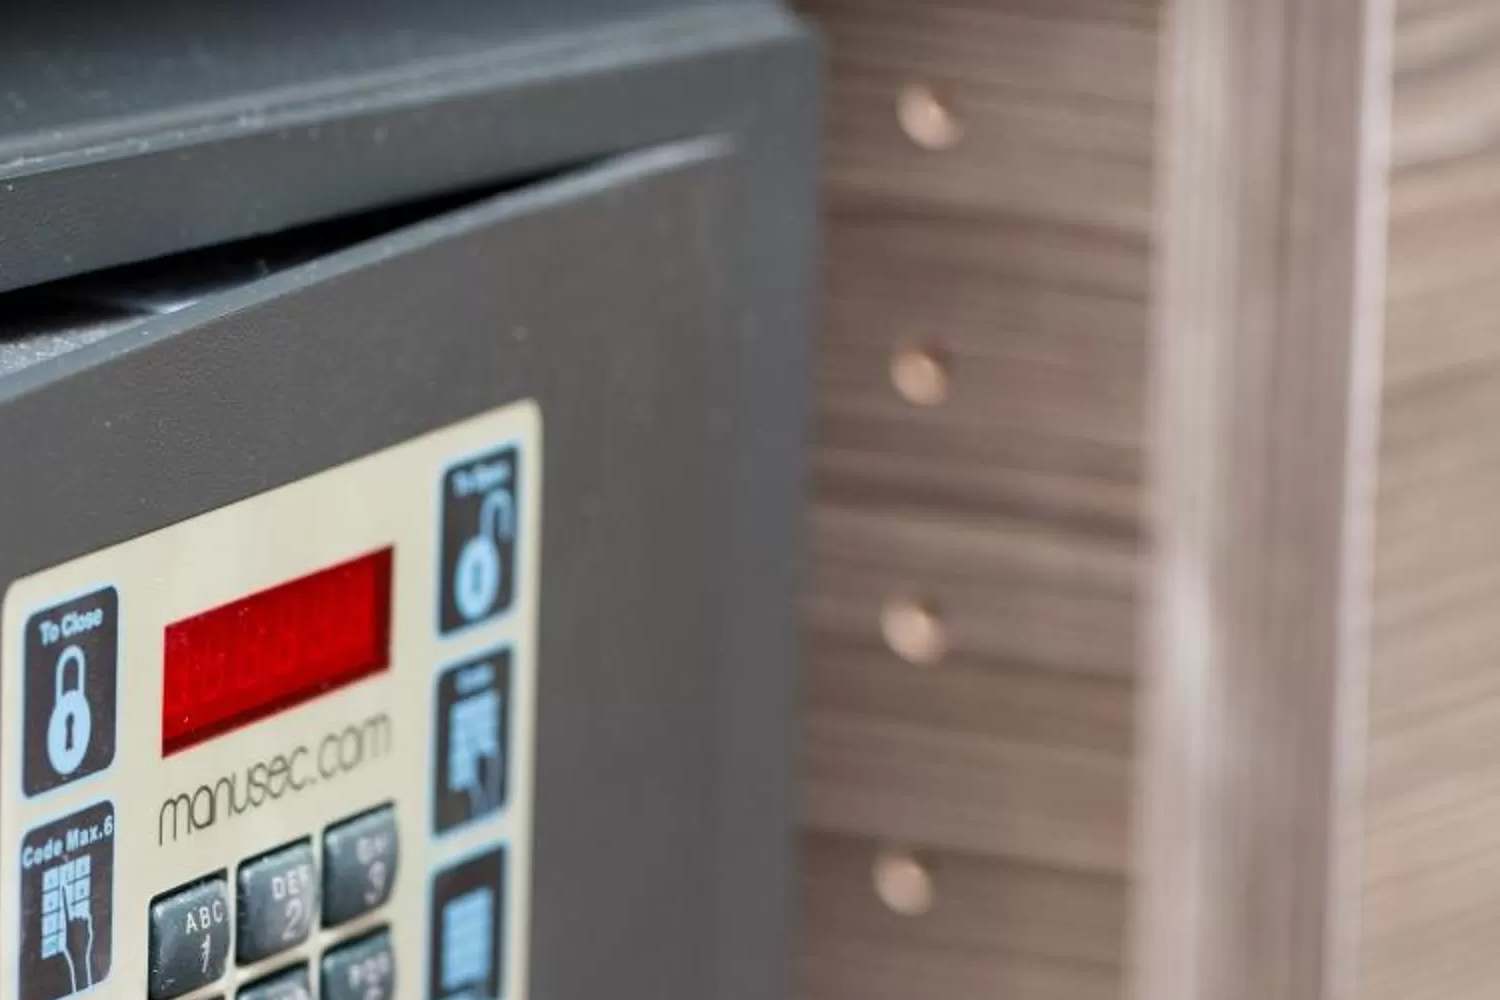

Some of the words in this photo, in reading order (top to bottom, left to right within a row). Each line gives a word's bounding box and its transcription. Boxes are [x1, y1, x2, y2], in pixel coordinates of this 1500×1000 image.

[38, 619, 60, 647] To
[61, 608, 104, 637] Close
[158, 711, 393, 848] manusec.com
[22, 838, 64, 869] Code
[185, 899, 224, 935] ABC
[281, 900, 304, 942] 2
[199, 933, 213, 974] 1
